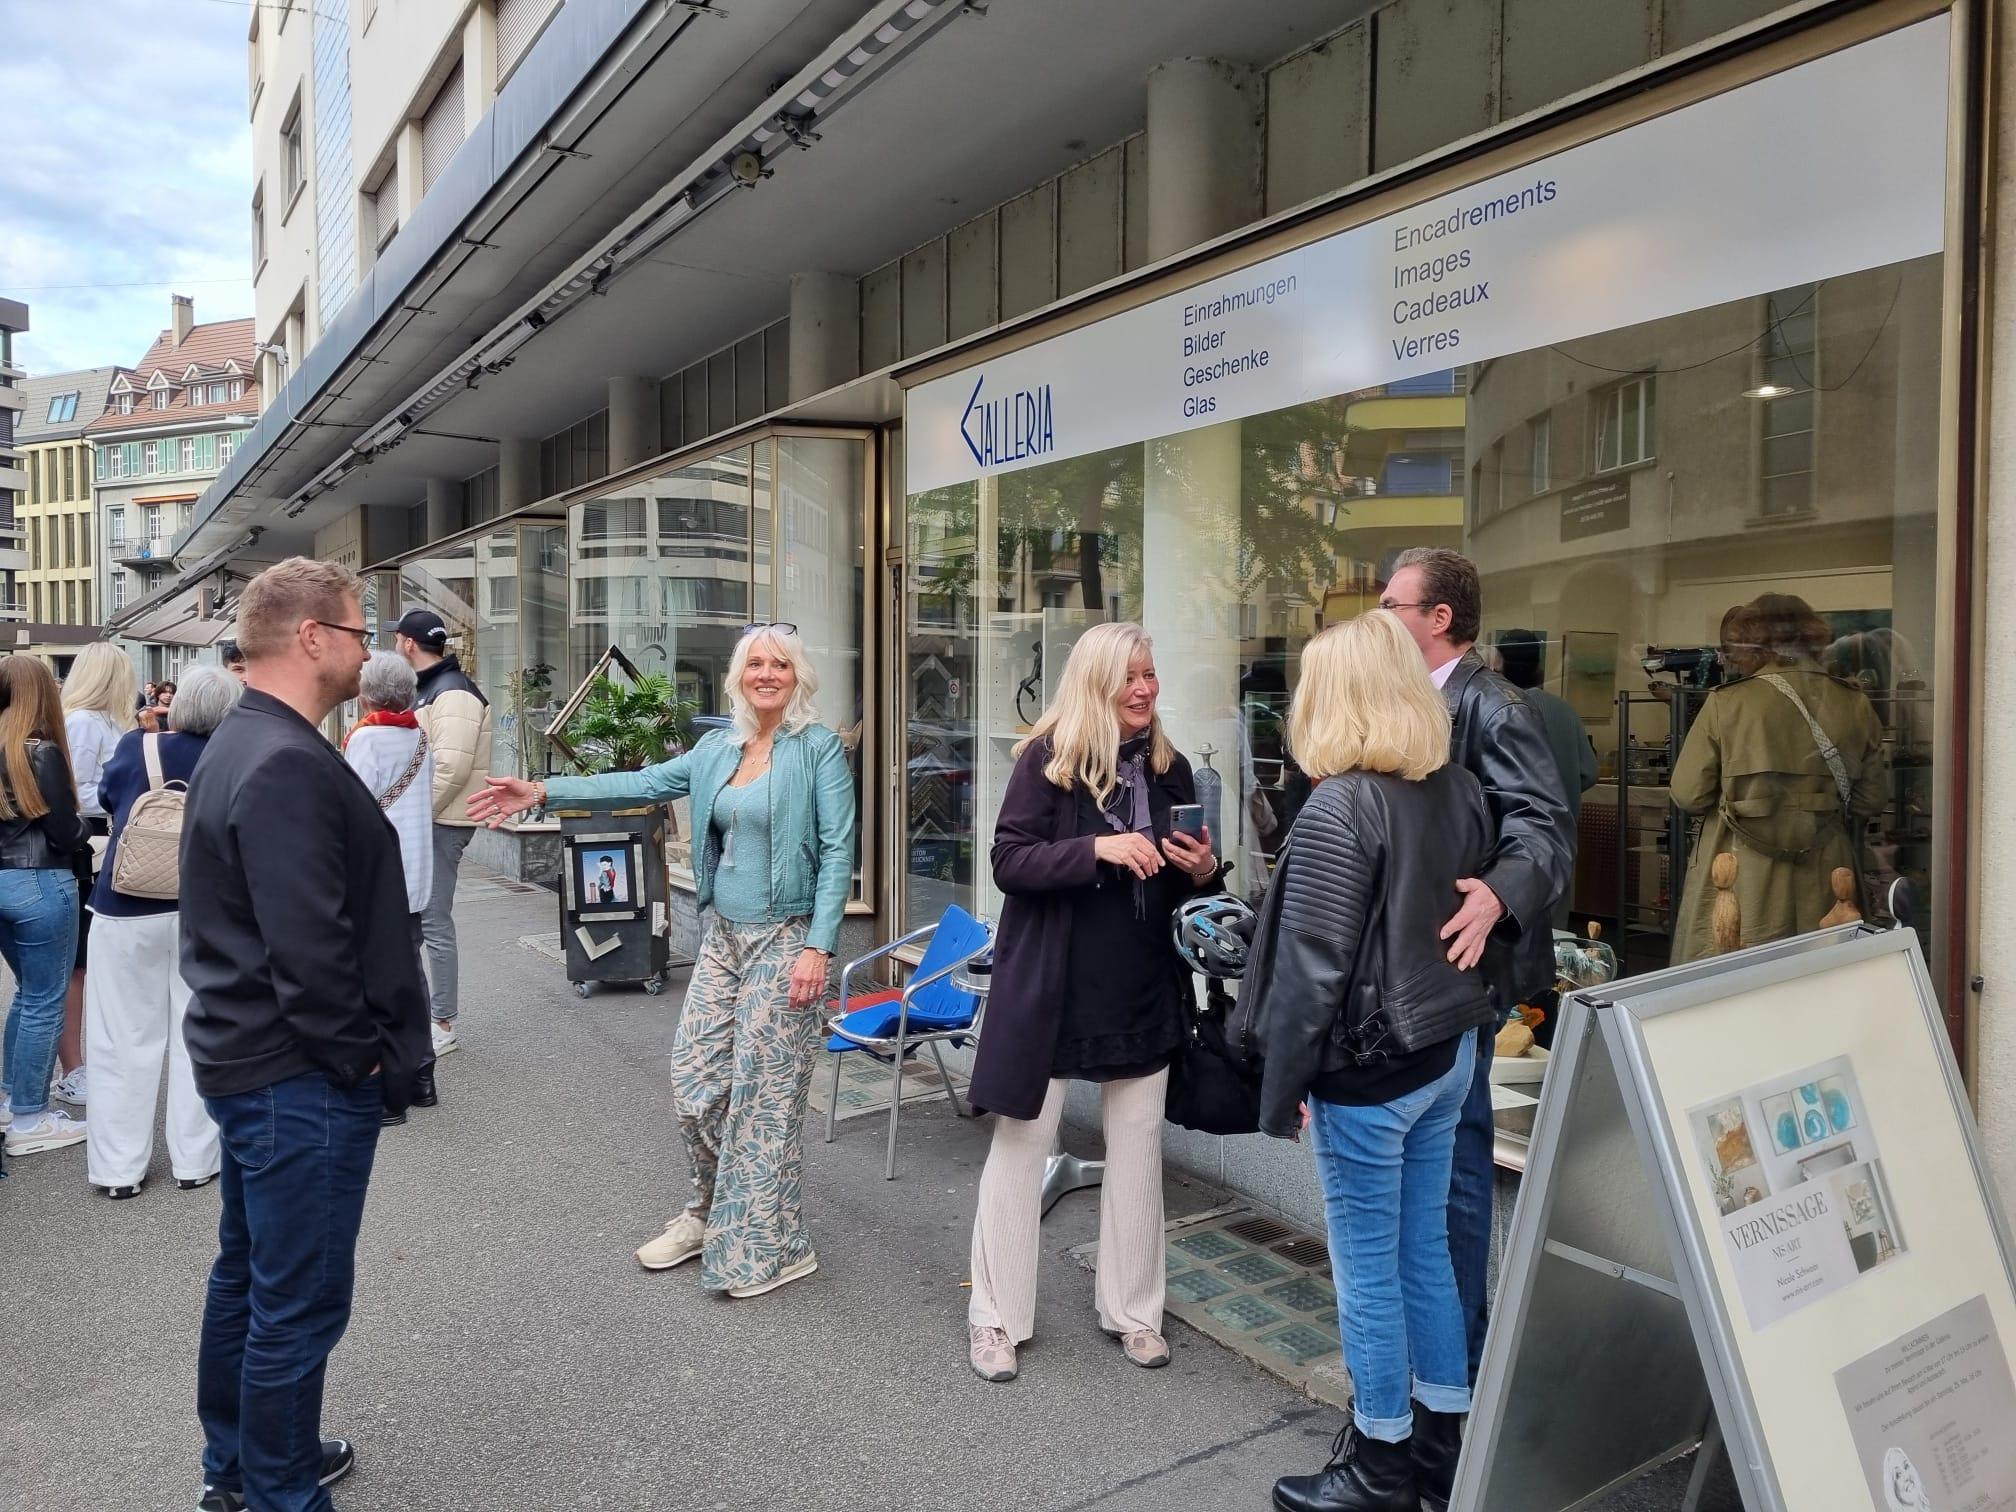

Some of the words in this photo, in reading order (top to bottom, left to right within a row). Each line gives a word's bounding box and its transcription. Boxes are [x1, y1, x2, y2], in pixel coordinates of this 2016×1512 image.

[1394, 179, 1558, 253] Encadrements
[1394, 246, 1472, 289] Images
[1183, 274, 1298, 327] Einrahmungen
[1393, 281, 1490, 325] Cadeaux
[1183, 328, 1226, 357] Bilder
[1392, 326, 1461, 361] Verres
[1183, 347, 1270, 387] Geschenke
[960, 374, 1054, 468] GALLERIA
[1183, 394, 1217, 418] Glas
[1729, 1191, 1828, 1251] VERNISSAGE
